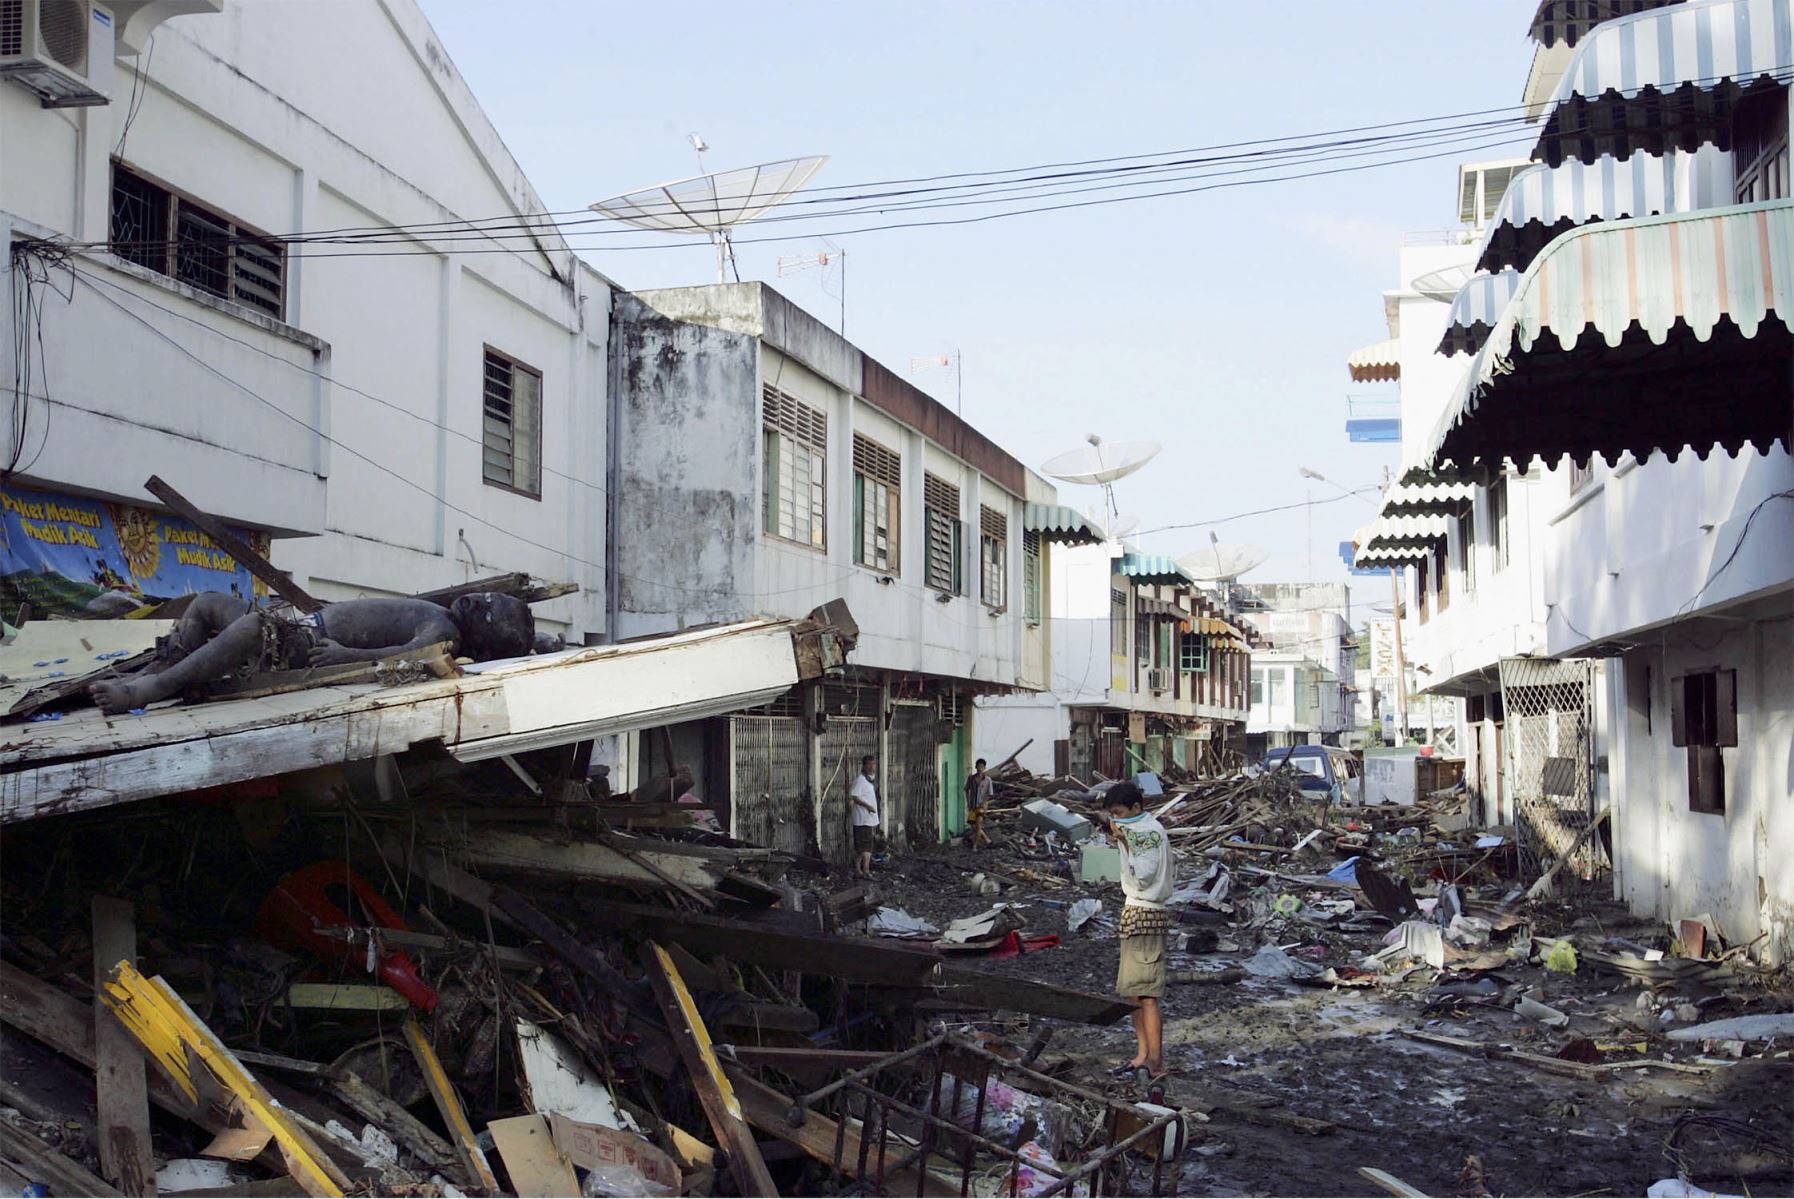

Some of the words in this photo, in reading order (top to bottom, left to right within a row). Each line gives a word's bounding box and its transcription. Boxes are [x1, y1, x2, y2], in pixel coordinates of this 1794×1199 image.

[164, 524, 198, 545] Paket
[176, 547, 212, 569] Mudik
[212, 552, 237, 574] Asik
